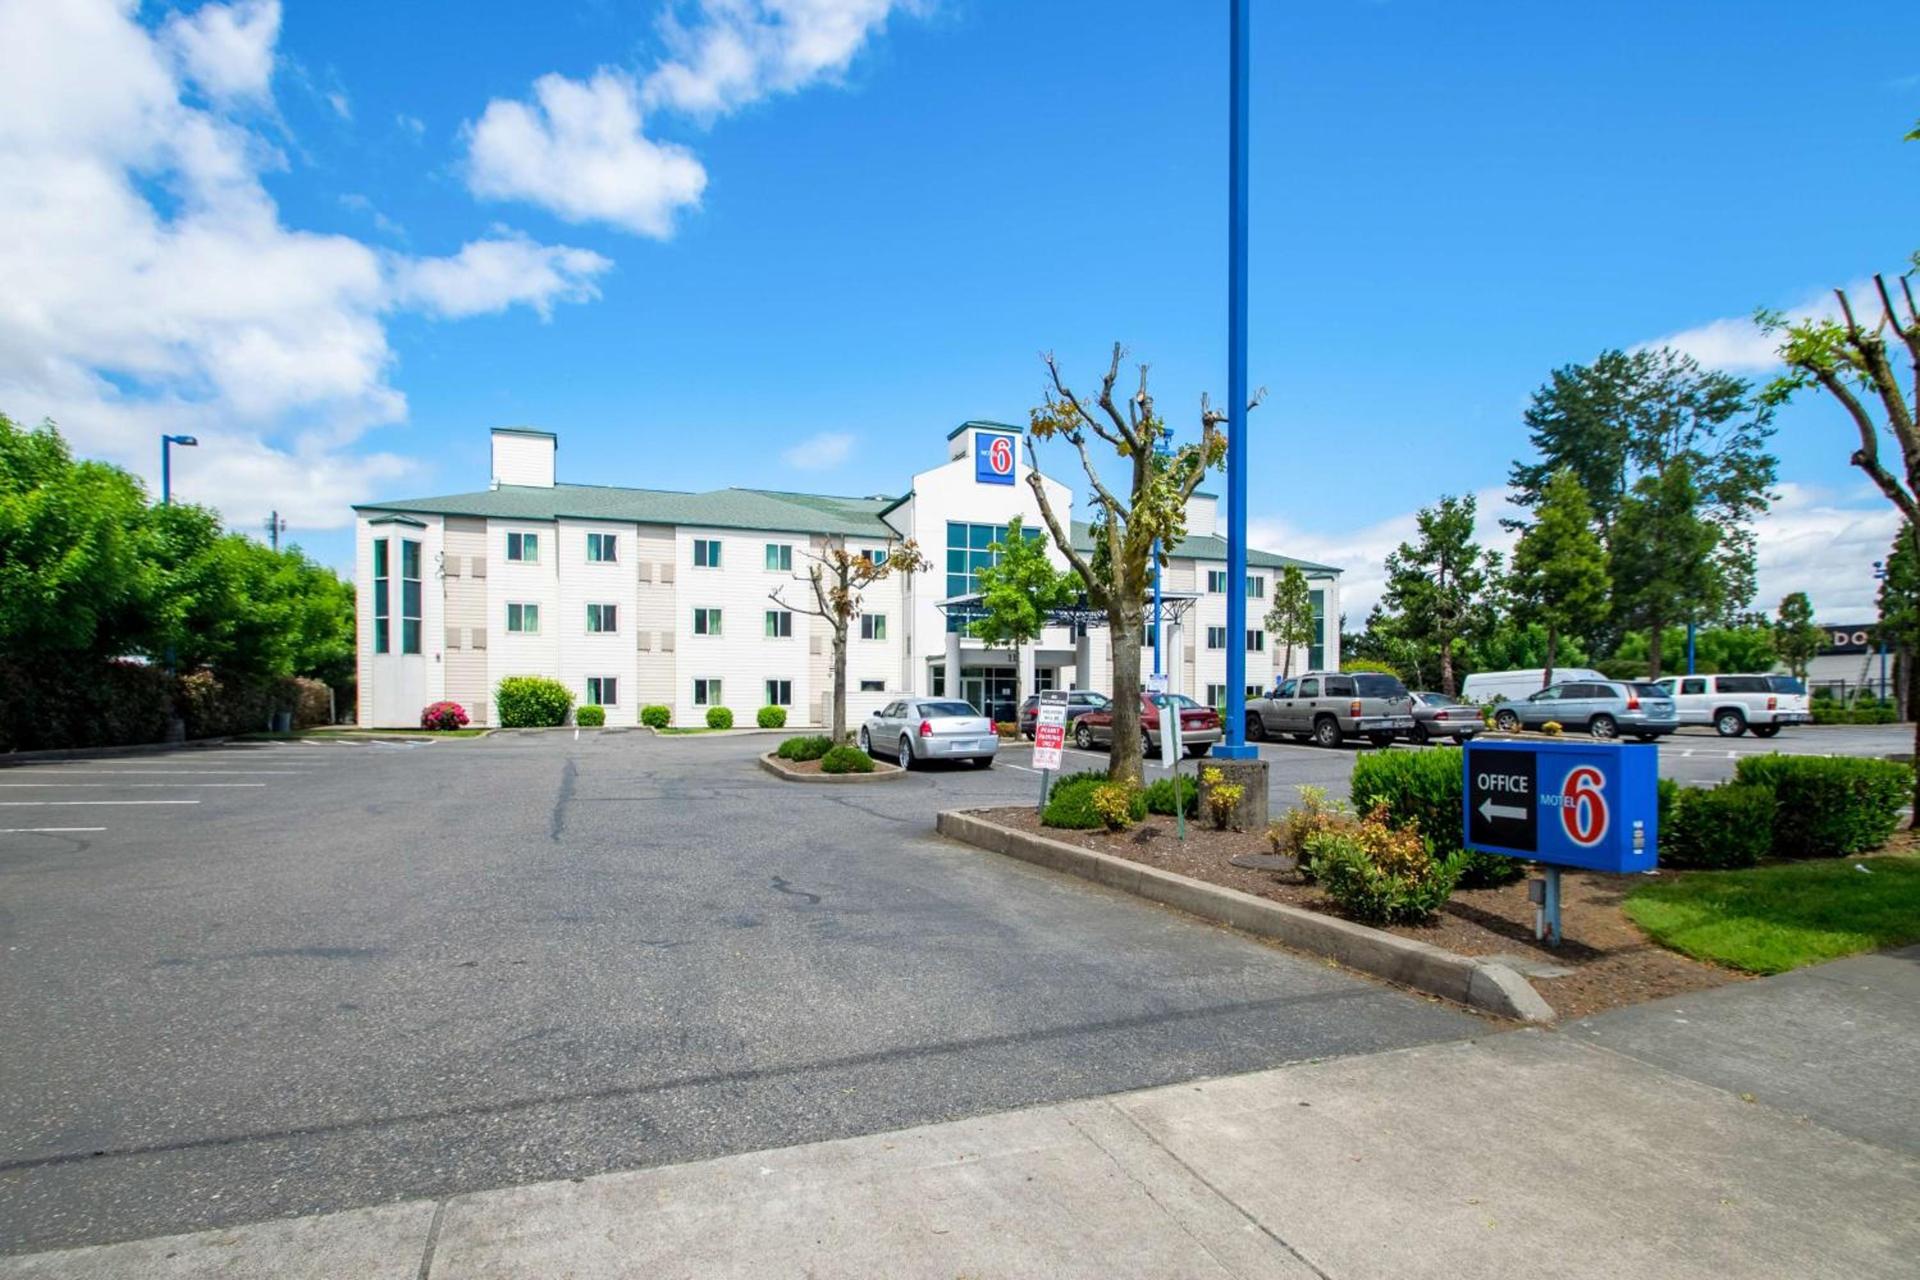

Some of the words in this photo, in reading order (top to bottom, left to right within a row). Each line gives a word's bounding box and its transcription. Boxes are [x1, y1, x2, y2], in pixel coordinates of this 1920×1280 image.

[990, 437, 1013, 475] 6
[1477, 773, 1529, 794] OFFICE
[1540, 794, 1577, 808] MOTEL
[1559, 764, 1609, 847] 6
